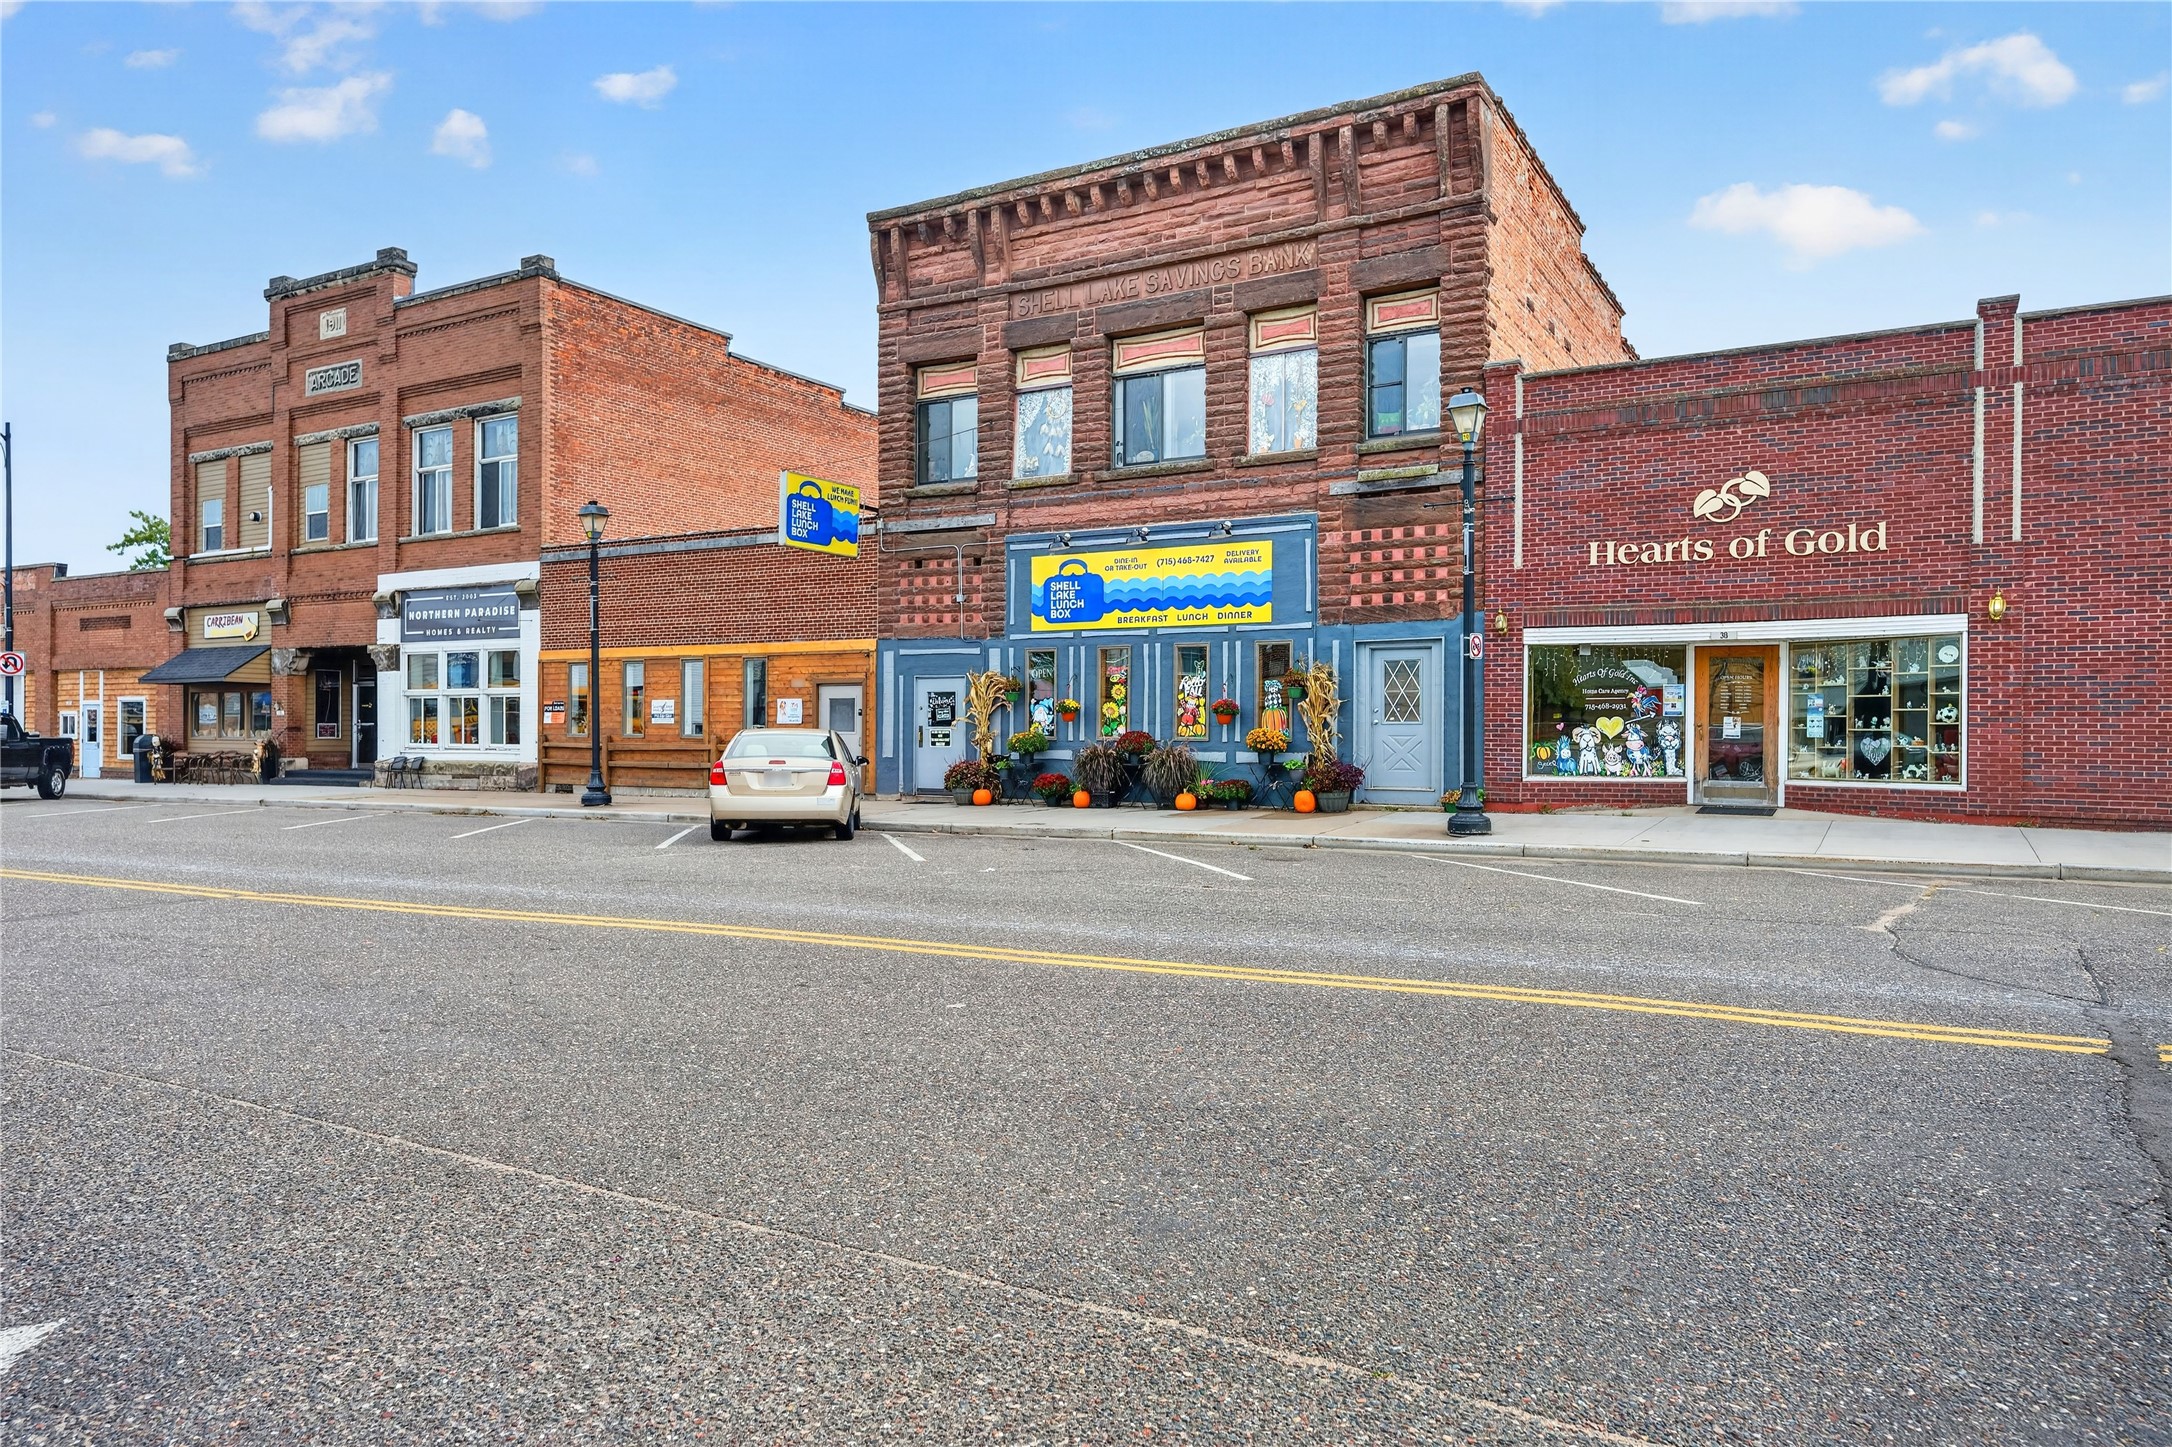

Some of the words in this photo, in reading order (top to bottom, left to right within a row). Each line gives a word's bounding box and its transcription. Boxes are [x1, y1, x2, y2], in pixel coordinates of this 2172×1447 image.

[1017, 290, 1080, 317] SHELL
[1085, 275, 1141, 305] LAKE
[1145, 257, 1241, 293] SAVINGS
[1248, 243, 1312, 276] BANK
[326, 315, 343, 332] 1911
[310, 365, 358, 391] ARCADE
[827, 493, 845, 503] LUNCH
[791, 499, 816, 513] SHELL
[791, 508, 812, 521] LAKE
[791, 518, 819, 531] LUNCH
[791, 527, 808, 538] BOX
[1588, 534, 1714, 567] Hearts
[1728, 528, 1772, 560] of
[1784, 521, 1888, 557] Gold
[1226, 549, 1260, 557] DELIVERY
[1223, 556, 1262, 564] AVAILABLE
[1116, 563, 1148, 571] TAKE-OUT
[1050, 580, 1081, 591] SHELL
[1050, 590, 1076, 600] LAKE
[1050, 599, 1085, 610] LUNCH
[408, 608, 460, 620] NORTHERN
[464, 605, 516, 618] PARADISE
[1050, 608, 1071, 619] BOX
[1117, 614, 1168, 624] BREAKFAST
[1177, 613, 1209, 622] LUNCH
[1217, 610, 1253, 620] DINNER
[207, 614, 244, 628] CARRIBEAN
[426, 628, 453, 636] HOMES
[465, 626, 496, 635] REALTY
[1030, 667, 1054, 680] OPEN
[1572, 670, 1597, 687] Hearts
[1597, 667, 1609, 679] Of
[1608, 668, 1628, 679] Gold
[1625, 673, 1639, 685] Inc
[1584, 702, 1627, 710] 715-468-2931
